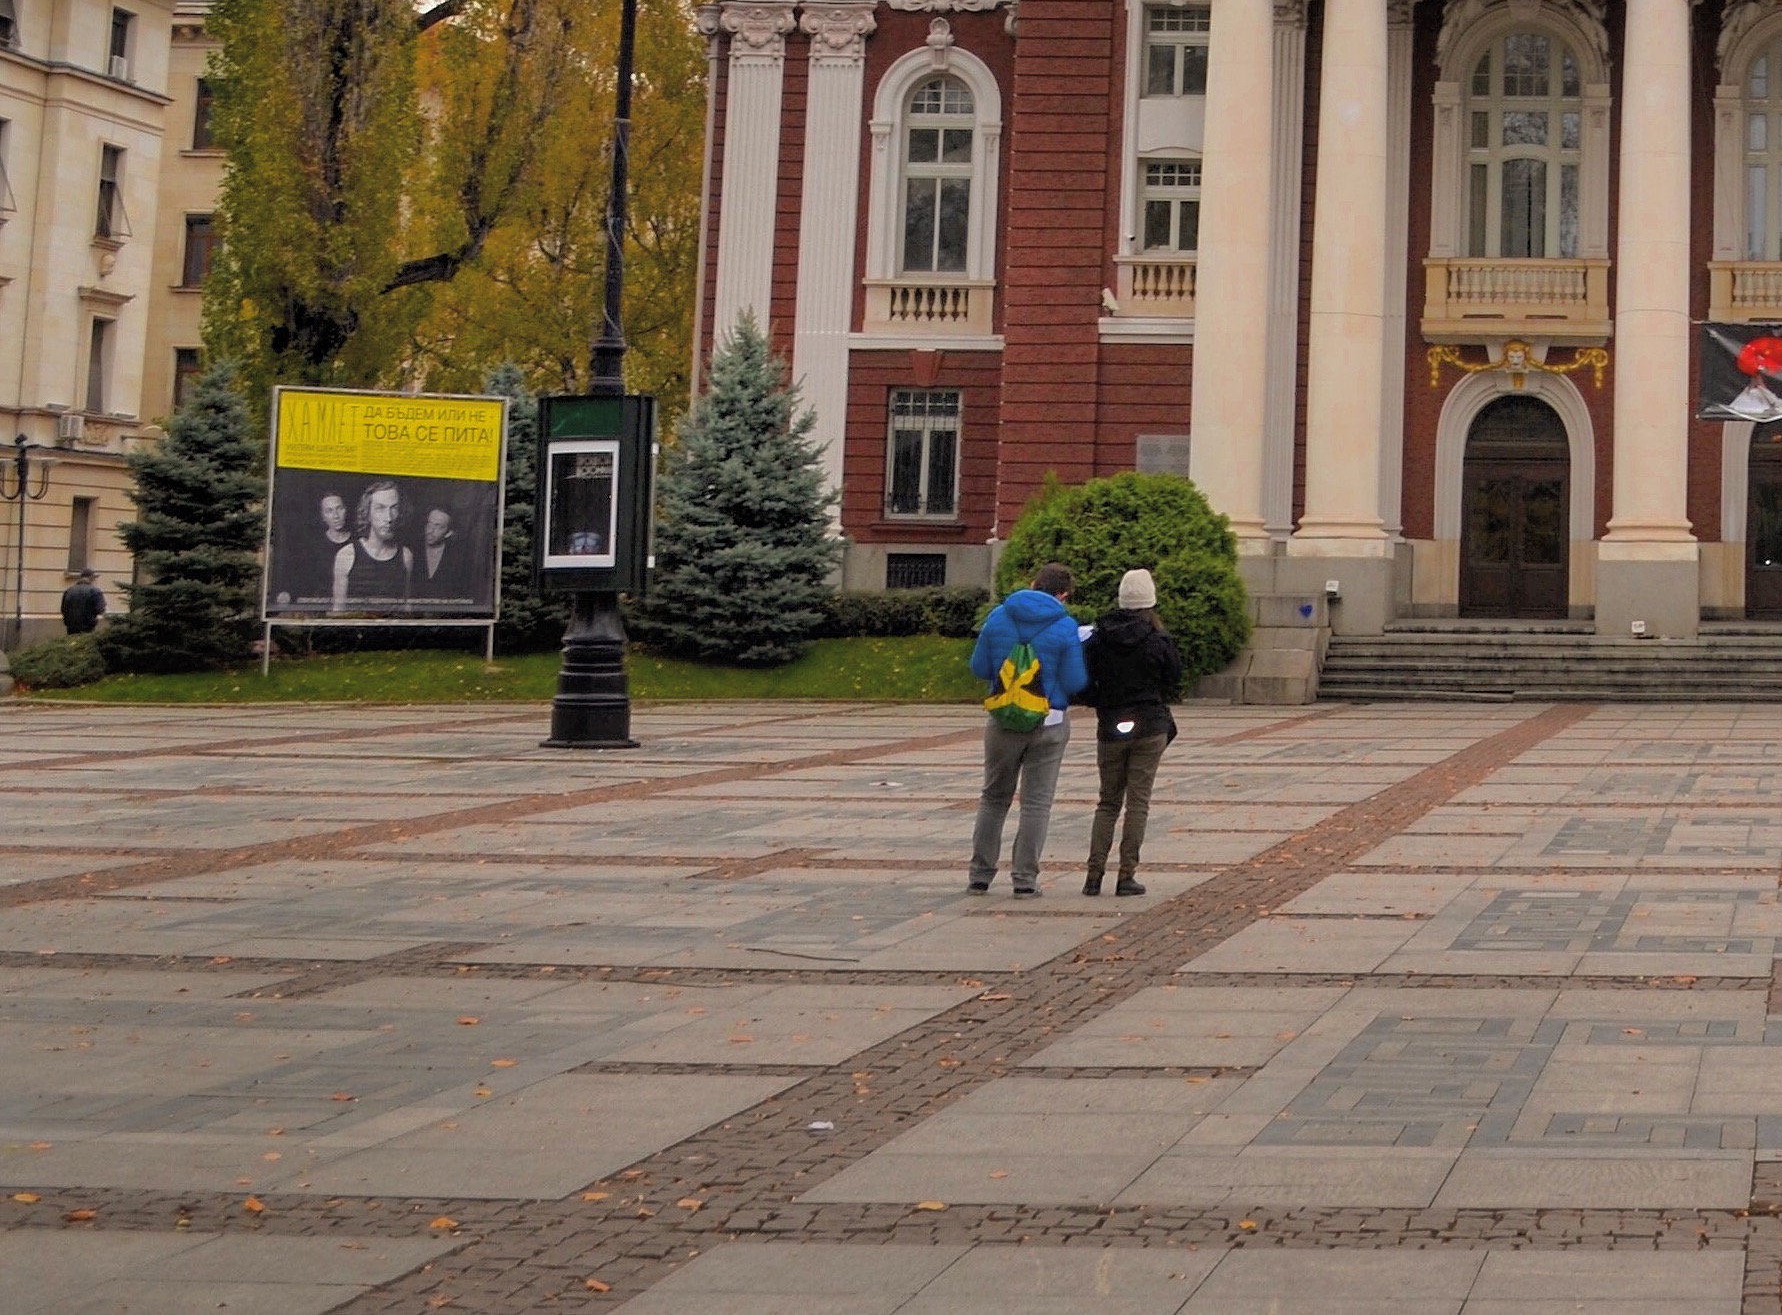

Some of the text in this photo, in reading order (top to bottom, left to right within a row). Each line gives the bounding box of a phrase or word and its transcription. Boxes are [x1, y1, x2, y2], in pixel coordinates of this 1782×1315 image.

[363, 405, 382, 419] ДА
[385, 406, 435, 421] БЪДЕМ
[437, 409, 465, 421] ИЛИ
[468, 411, 487, 423] НЕ
[363, 423, 494, 444] ТОВА СЕ ПИТА!
